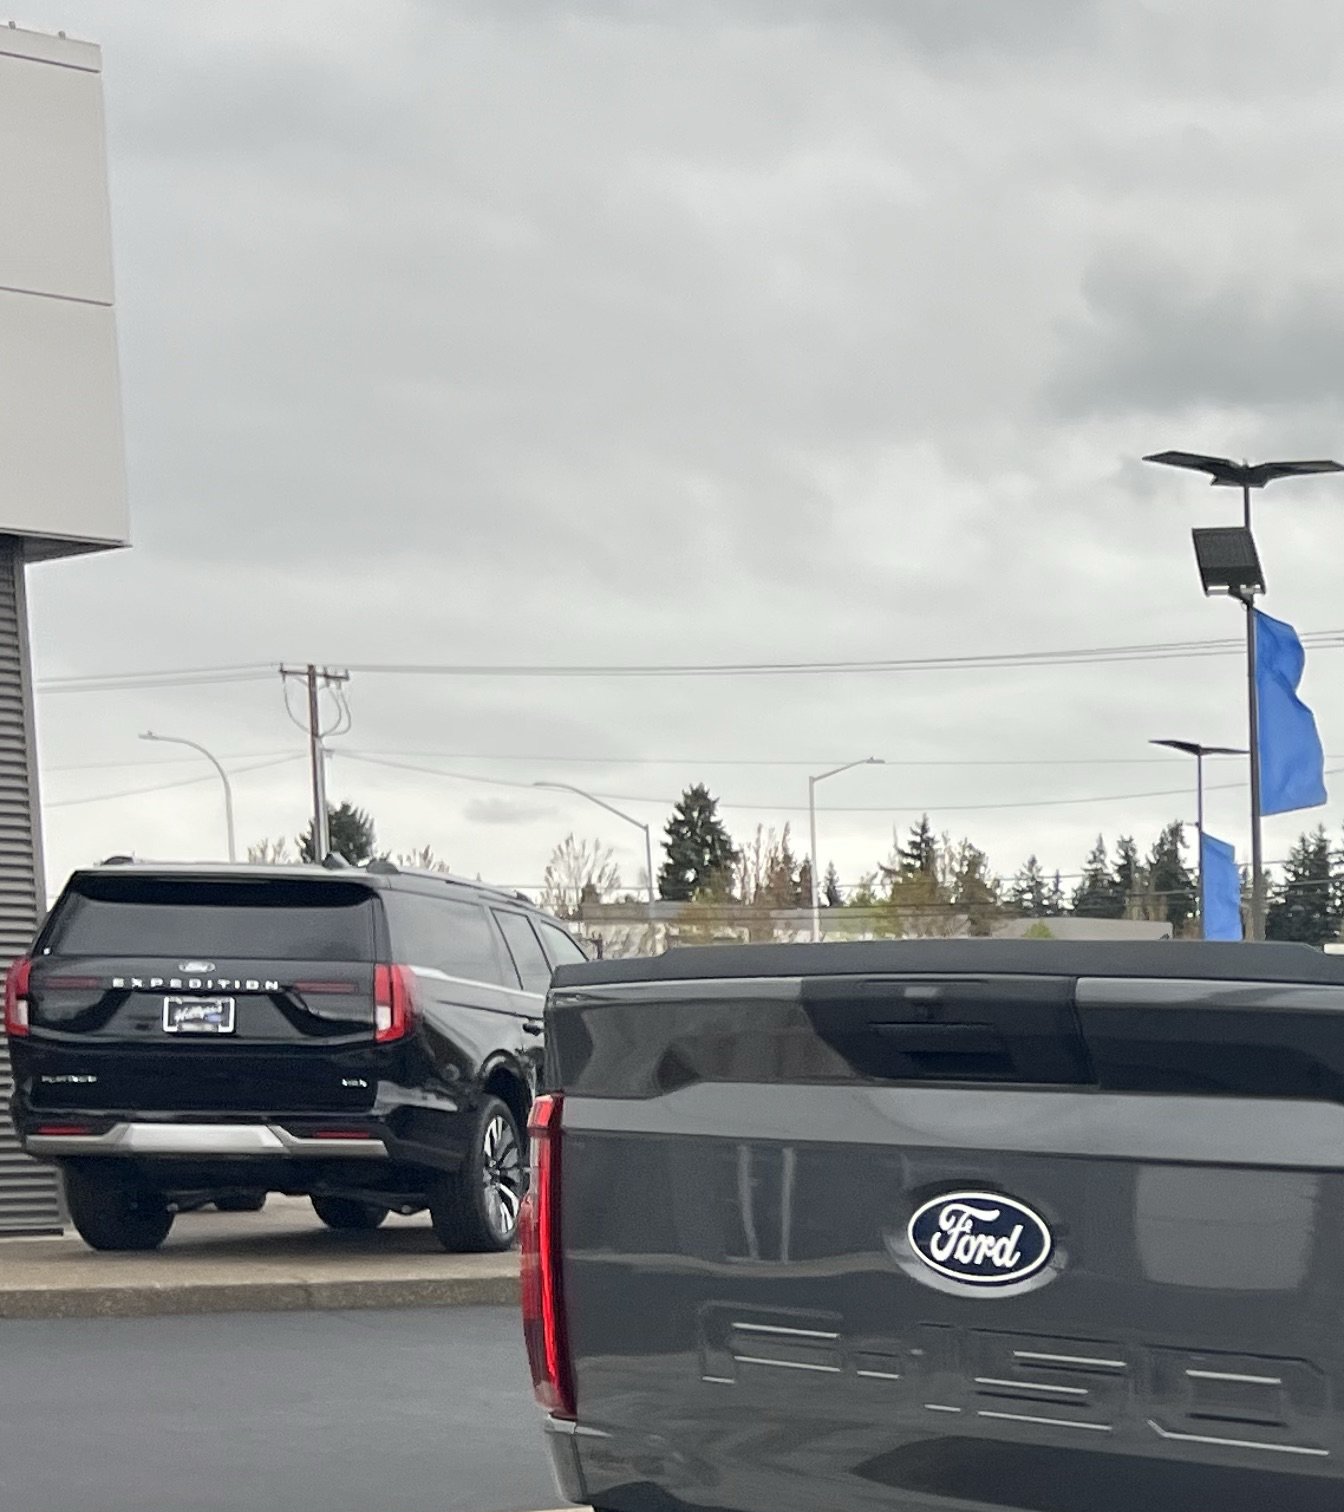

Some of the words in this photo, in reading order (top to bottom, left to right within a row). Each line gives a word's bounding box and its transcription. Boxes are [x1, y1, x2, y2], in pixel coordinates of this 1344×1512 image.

[112, 977, 279, 990] EXPEDITION
[930, 1203, 1024, 1268] Ford
[701, 1301, 1331, 1456] F-150
